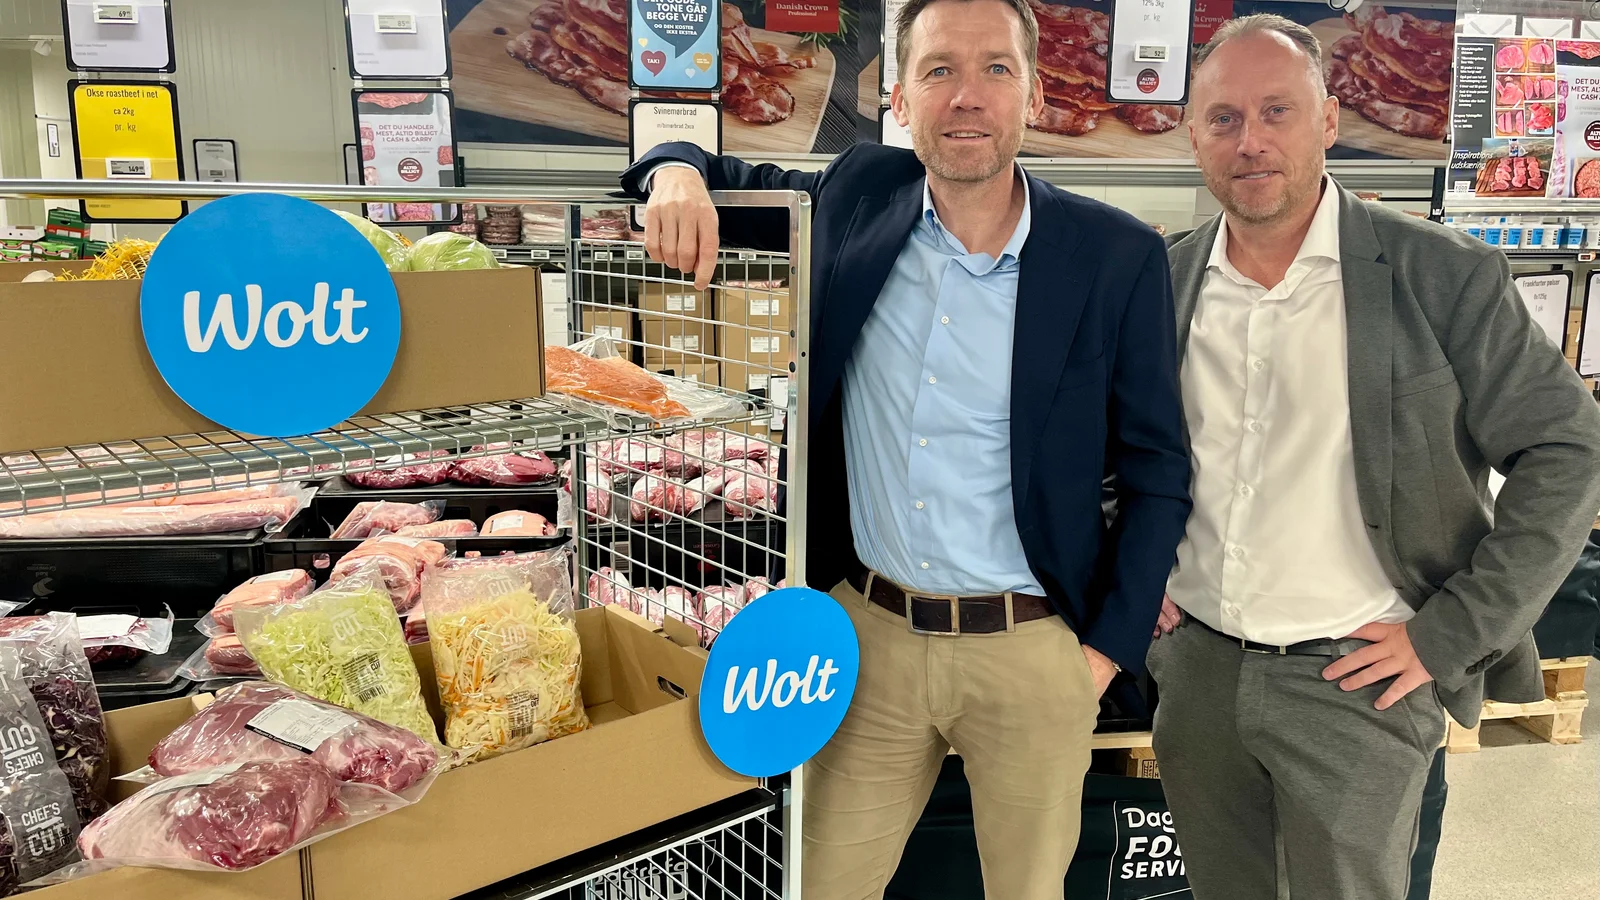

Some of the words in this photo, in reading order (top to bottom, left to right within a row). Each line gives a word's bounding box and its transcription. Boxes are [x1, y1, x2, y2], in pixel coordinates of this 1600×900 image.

[657, 3, 683, 12] TONE
[686, 3, 707, 14] GÅR
[646, 12, 679, 21] BEGGE
[682, 13, 704, 22] VEJE
[1153, 14, 1161, 22] kg
[86, 88, 104, 98] Okse
[106, 89, 140, 98] roastbeef
[146, 90, 159, 98] net
[122, 107, 135, 116] 2kg
[114, 124, 125, 132] pr.
[127, 123, 136, 132] kg
[1453, 151, 1494, 160] Inspirations
[1451, 161, 1486, 170] udskæring
[183, 282, 369, 353] Wolt
[723, 655, 839, 714] Wolt
[5, 752, 44, 774] CHEF'S
[21, 802, 61, 827] CHEF'S
[27, 822, 65, 857] CUT
[1120, 859, 1185, 879] SERVI
